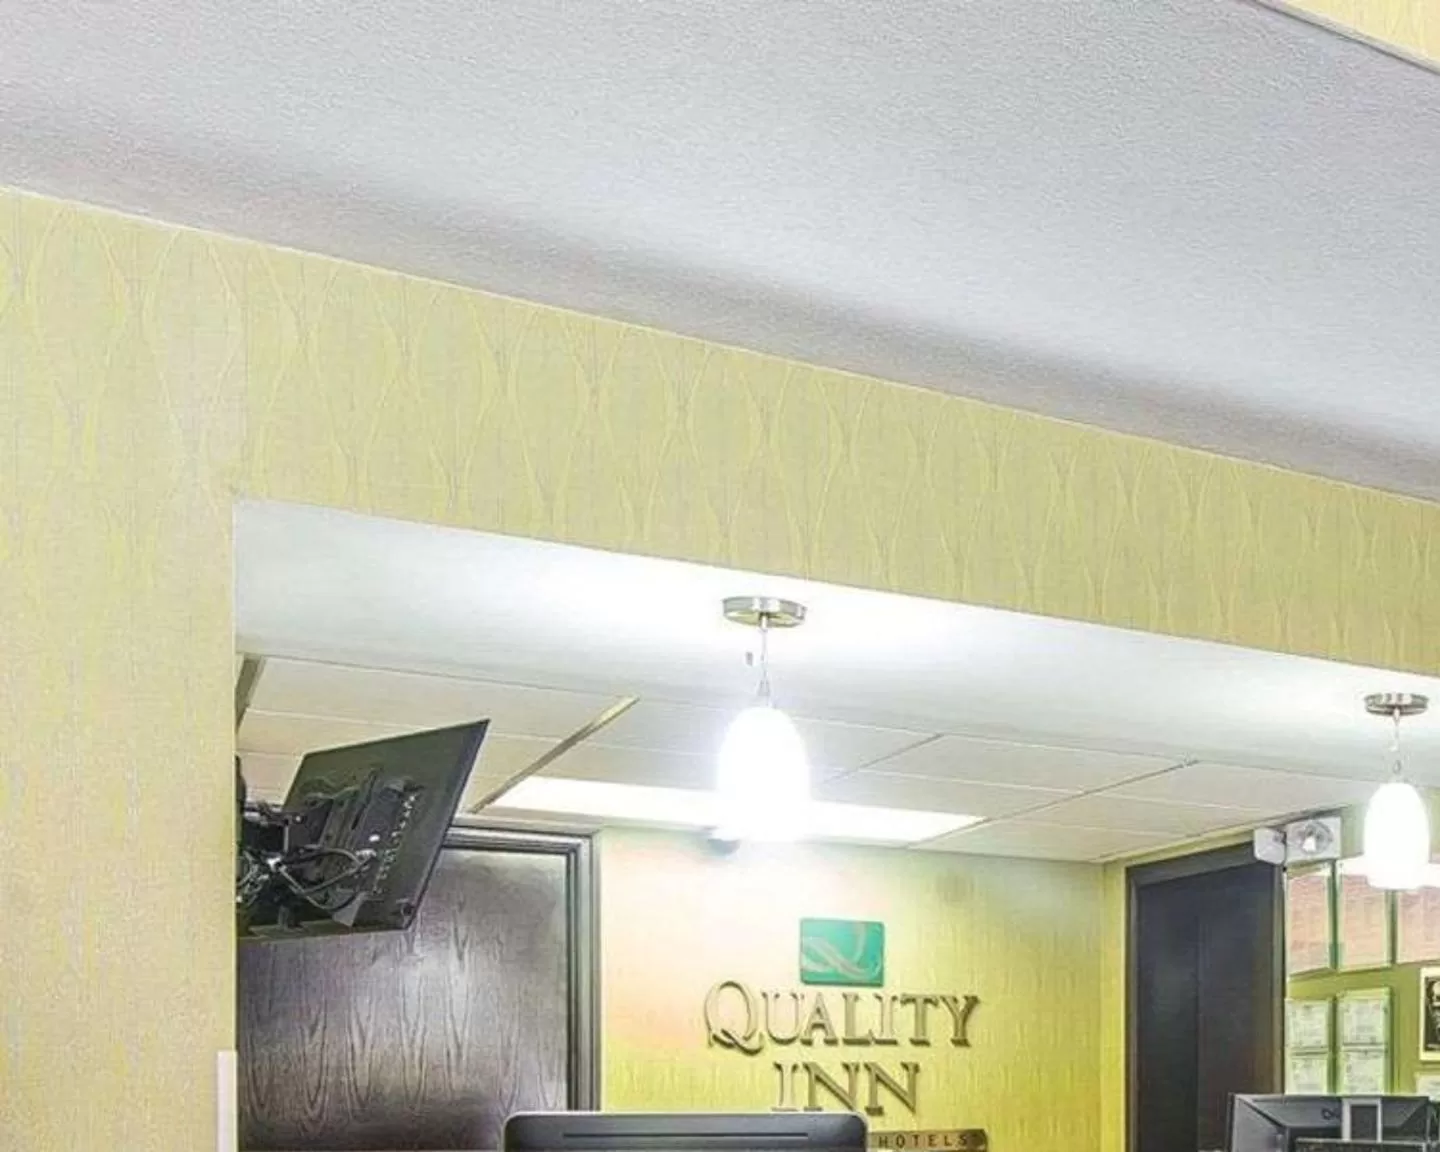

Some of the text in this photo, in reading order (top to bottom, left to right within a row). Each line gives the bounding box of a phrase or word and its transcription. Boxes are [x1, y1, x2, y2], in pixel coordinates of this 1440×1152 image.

[704, 980, 981, 1057] QUALITY
[771, 1061, 920, 1116] INN
[877, 1133, 968, 1149] HOTELS
